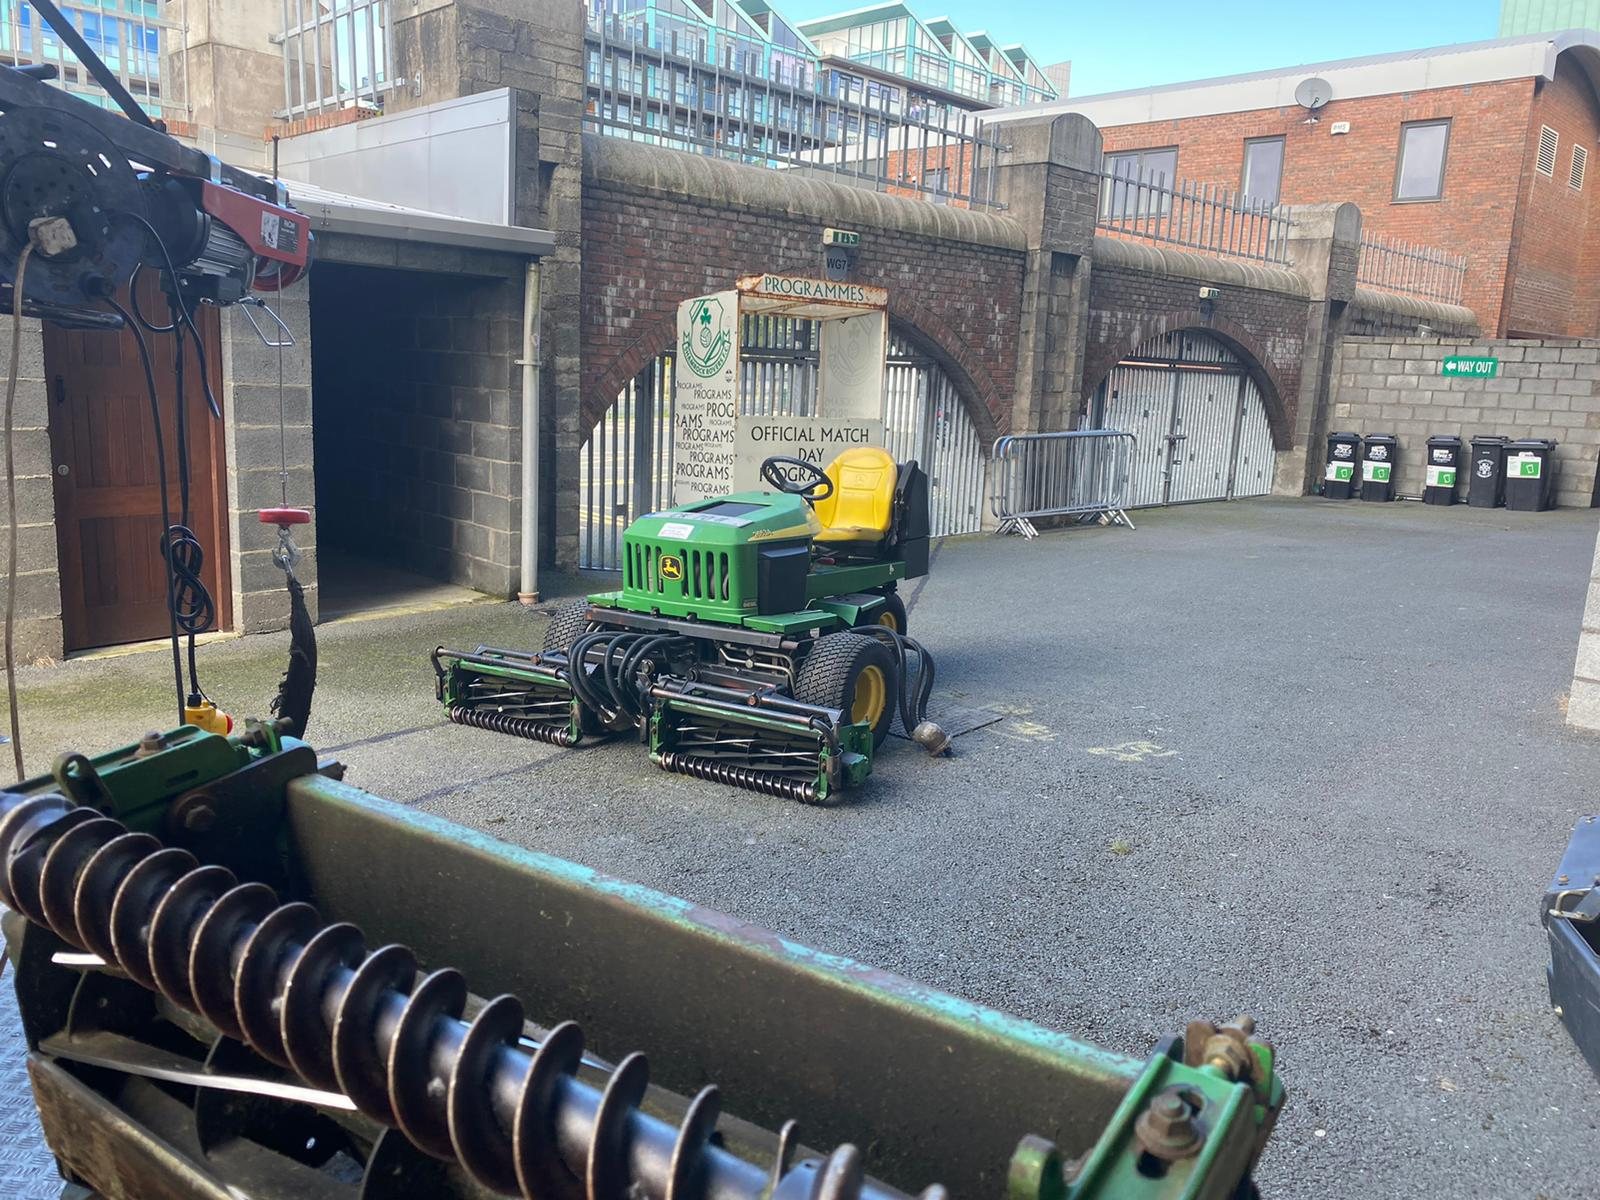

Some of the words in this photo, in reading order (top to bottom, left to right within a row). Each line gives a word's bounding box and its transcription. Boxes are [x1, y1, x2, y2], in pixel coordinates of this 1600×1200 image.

[827, 258, 846, 270] WG7
[764, 276, 864, 301] PROGRAMMES
[1457, 361, 1475, 373] WAY
[1476, 361, 1493, 373] OUT
[694, 389, 732, 400] PROGRAMS
[706, 402, 734, 418] PROG
[682, 428, 735, 443] PROGRAMS
[751, 426, 815, 442] OFFICIAL
[821, 428, 869, 443] MATCH
[689, 451, 734, 465] PROGRAMS
[799, 448, 824, 463] DAY
[676, 462, 729, 480] PROGRAMS
[690, 482, 730, 495] PROGRAMS
